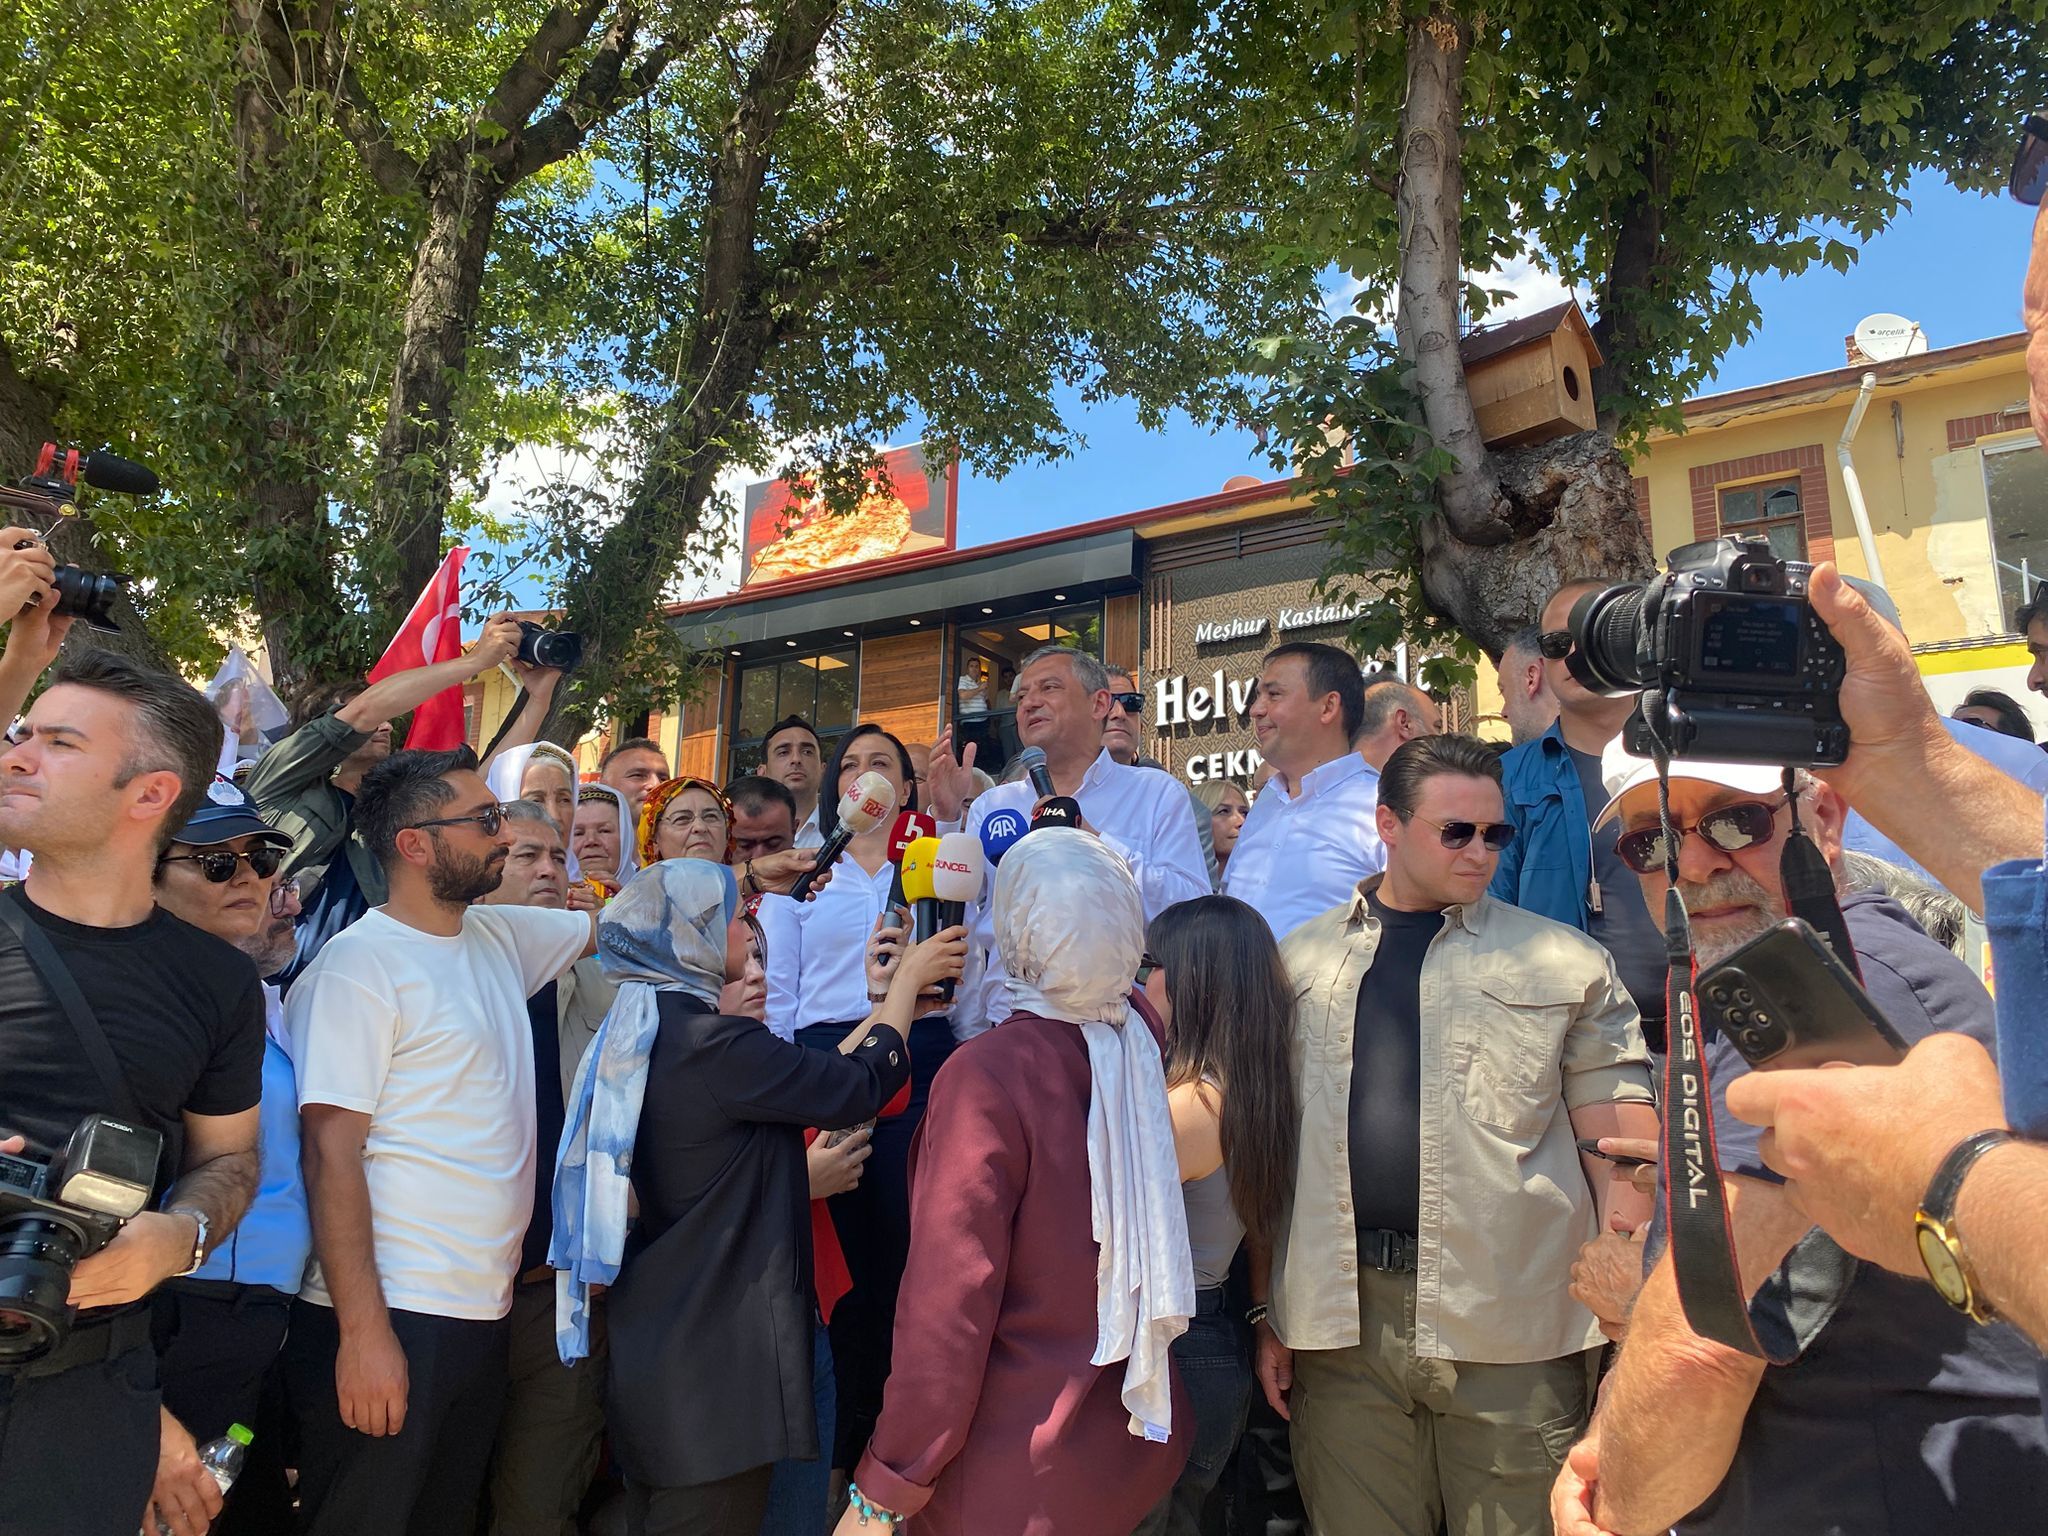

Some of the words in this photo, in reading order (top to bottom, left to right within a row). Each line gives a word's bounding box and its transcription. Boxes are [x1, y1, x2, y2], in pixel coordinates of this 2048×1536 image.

[1877, 328, 1905, 336] arçelik
[1195, 618, 1266, 642] Meşhur
[1186, 748, 1265, 785] ÇEKM
[988, 815, 1017, 840] AA
[1680, 991, 1696, 1061] EOS
[1682, 1074, 1708, 1208] DIGITAL
